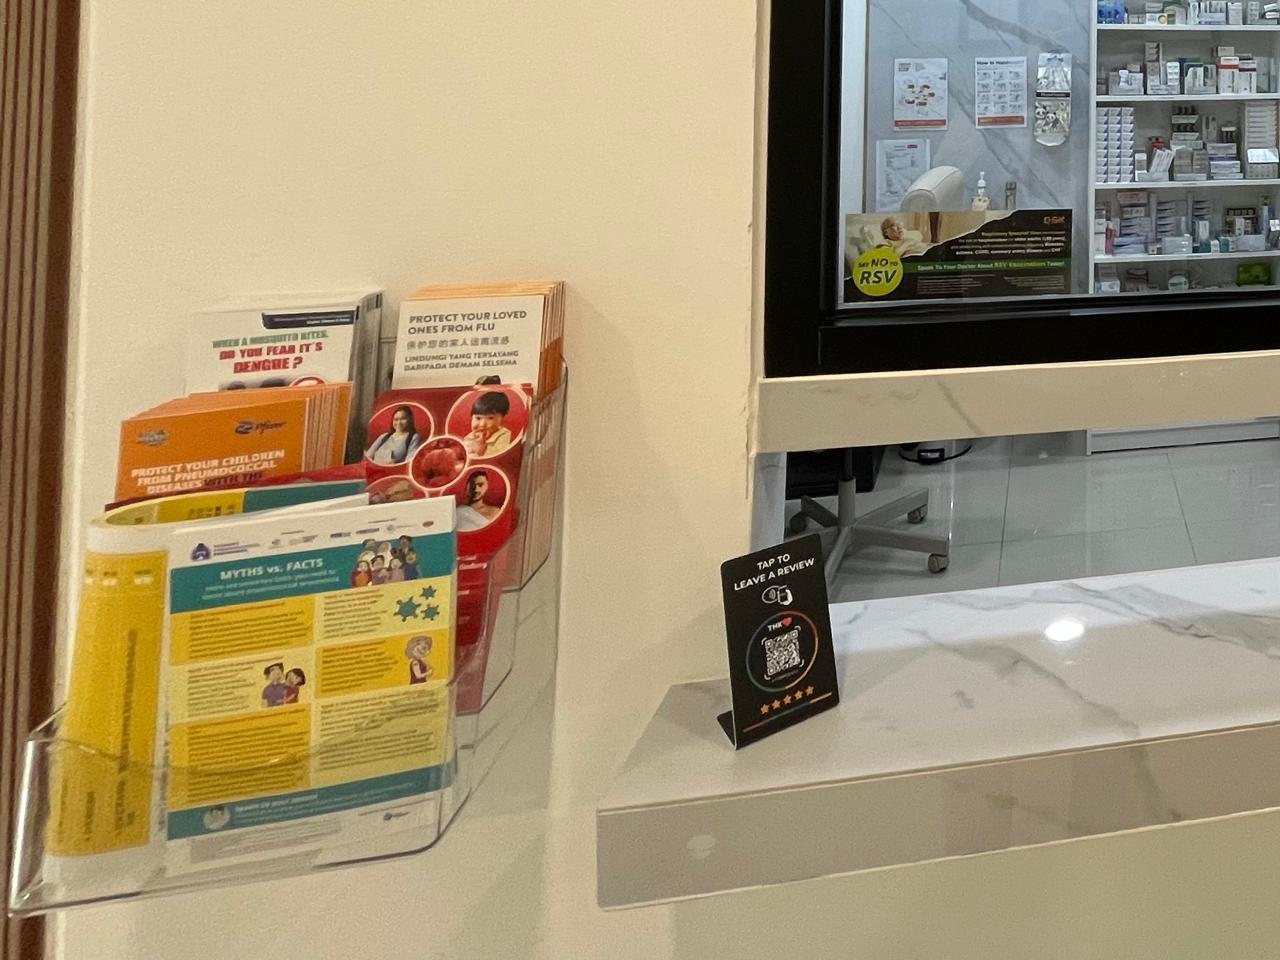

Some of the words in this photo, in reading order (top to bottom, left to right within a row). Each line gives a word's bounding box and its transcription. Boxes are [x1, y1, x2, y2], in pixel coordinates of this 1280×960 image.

[871, 258, 889, 268] NO
[859, 270, 897, 284] RSV
[409, 313, 458, 324] PROTECT
[461, 312, 491, 321] YOUR
[493, 310, 527, 320] LOVED
[408, 326, 439, 335] ONES
[441, 324, 473, 333] FROM
[476, 323, 495, 331] FLU
[241, 337, 249, 346] A
[219, 349, 236, 360] DO
[239, 347, 263, 358] YOU
[266, 344, 296, 356] FEAR
[404, 353, 448, 363] LINDUNGI
[449, 352, 472, 360] YANG
[473, 350, 519, 359] TERSAYANG
[233, 357, 290, 374] DENGUE
[292, 356, 304, 369] ?
[404, 363, 447, 372] DARIPADA
[449, 361, 481, 369] DEMAM
[482, 359, 518, 367] SELSEMA
[131, 463, 183, 478] PROTECT
[184, 458, 219, 472] YOUR
[222, 449, 285, 466] CHILDREN
[137, 472, 173, 486] FROM
[174, 460, 278, 480] PNEUMOCOCCAL
[220, 566, 264, 580] MYTHS
[266, 565, 284, 574] vs.
[286, 558, 323, 572] FACTS
[757, 558, 775, 570] TAP
[777, 553, 790, 564] TO
[734, 573, 766, 591] LEAVE
[768, 571, 776, 580] A
[777, 557, 815, 577] REVIEW
